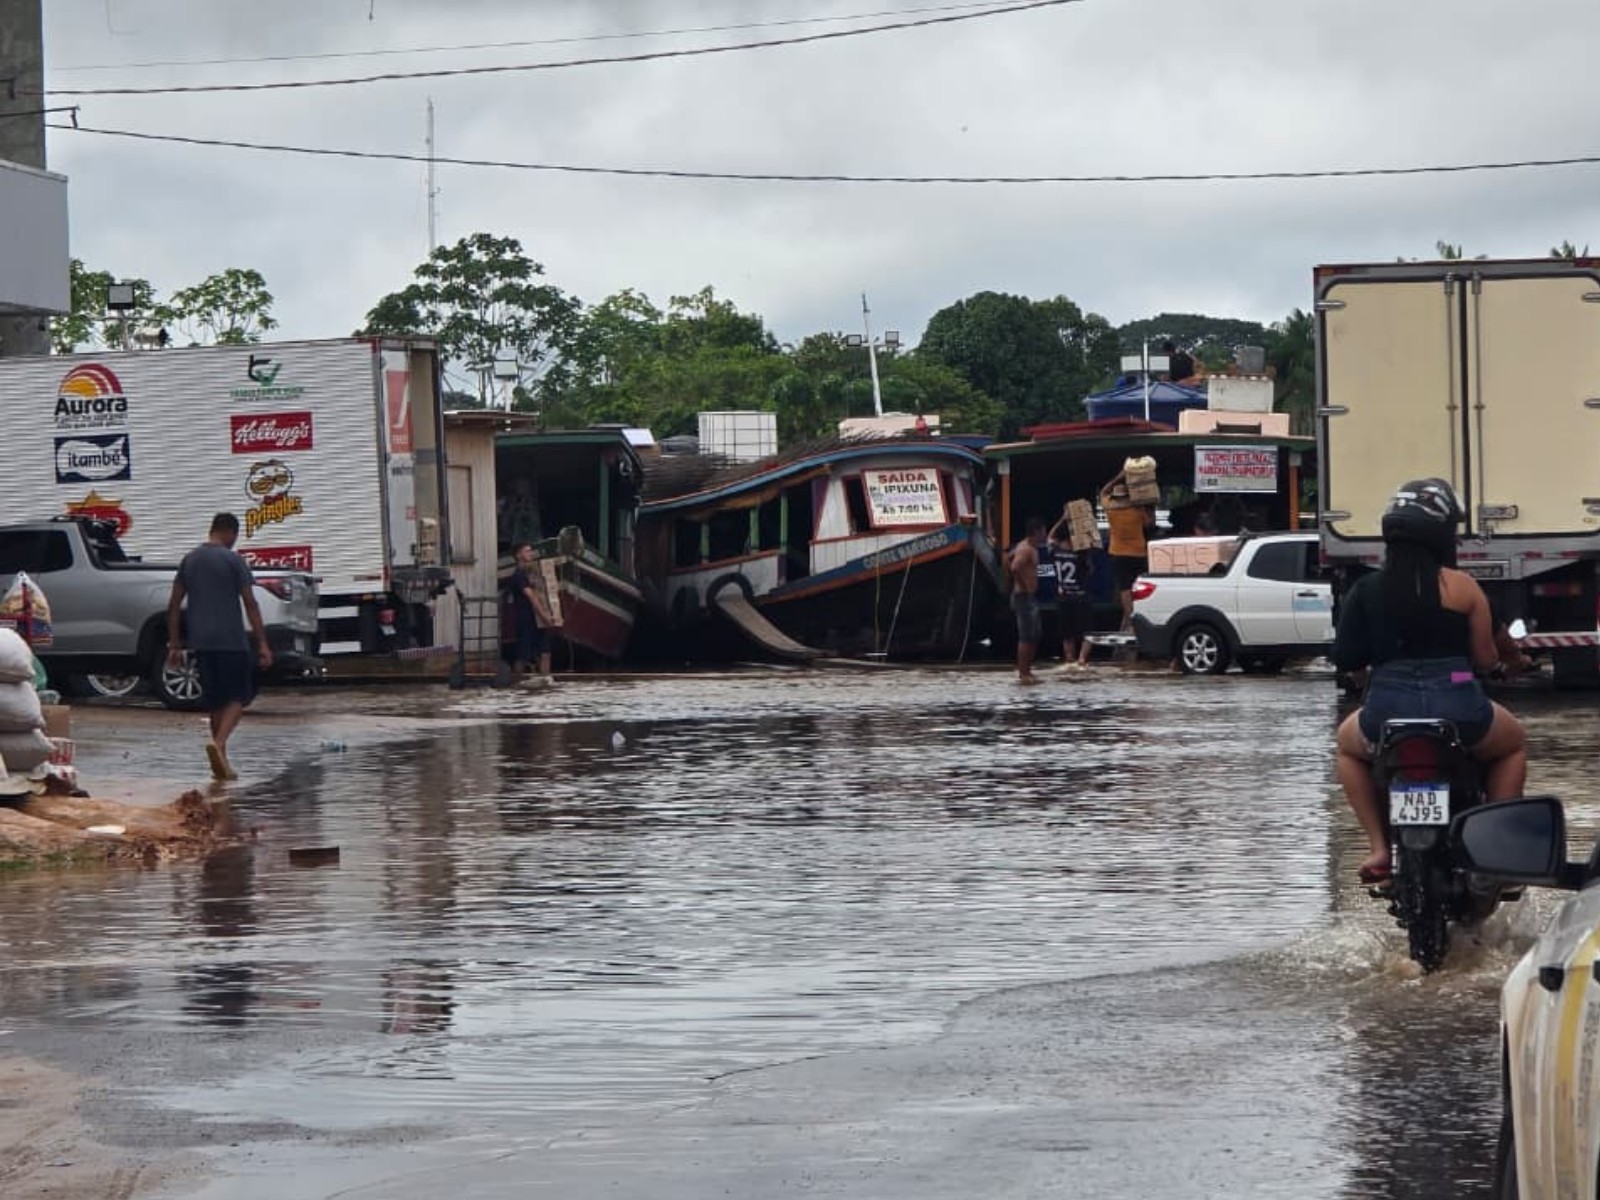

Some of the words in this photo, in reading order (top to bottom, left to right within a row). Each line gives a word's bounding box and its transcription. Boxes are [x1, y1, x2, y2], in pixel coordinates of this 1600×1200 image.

[54, 397, 128, 415] Aurora
[234, 420, 310, 446] Kellogg's
[68, 449, 120, 467] itambé
[884, 483, 938, 493] IPIXUNA
[245, 496, 303, 538] Pringles
[1055, 561, 1076, 583] 12
[1404, 792, 1436, 806] NAD
[1399, 806, 1442, 821] 4J95
